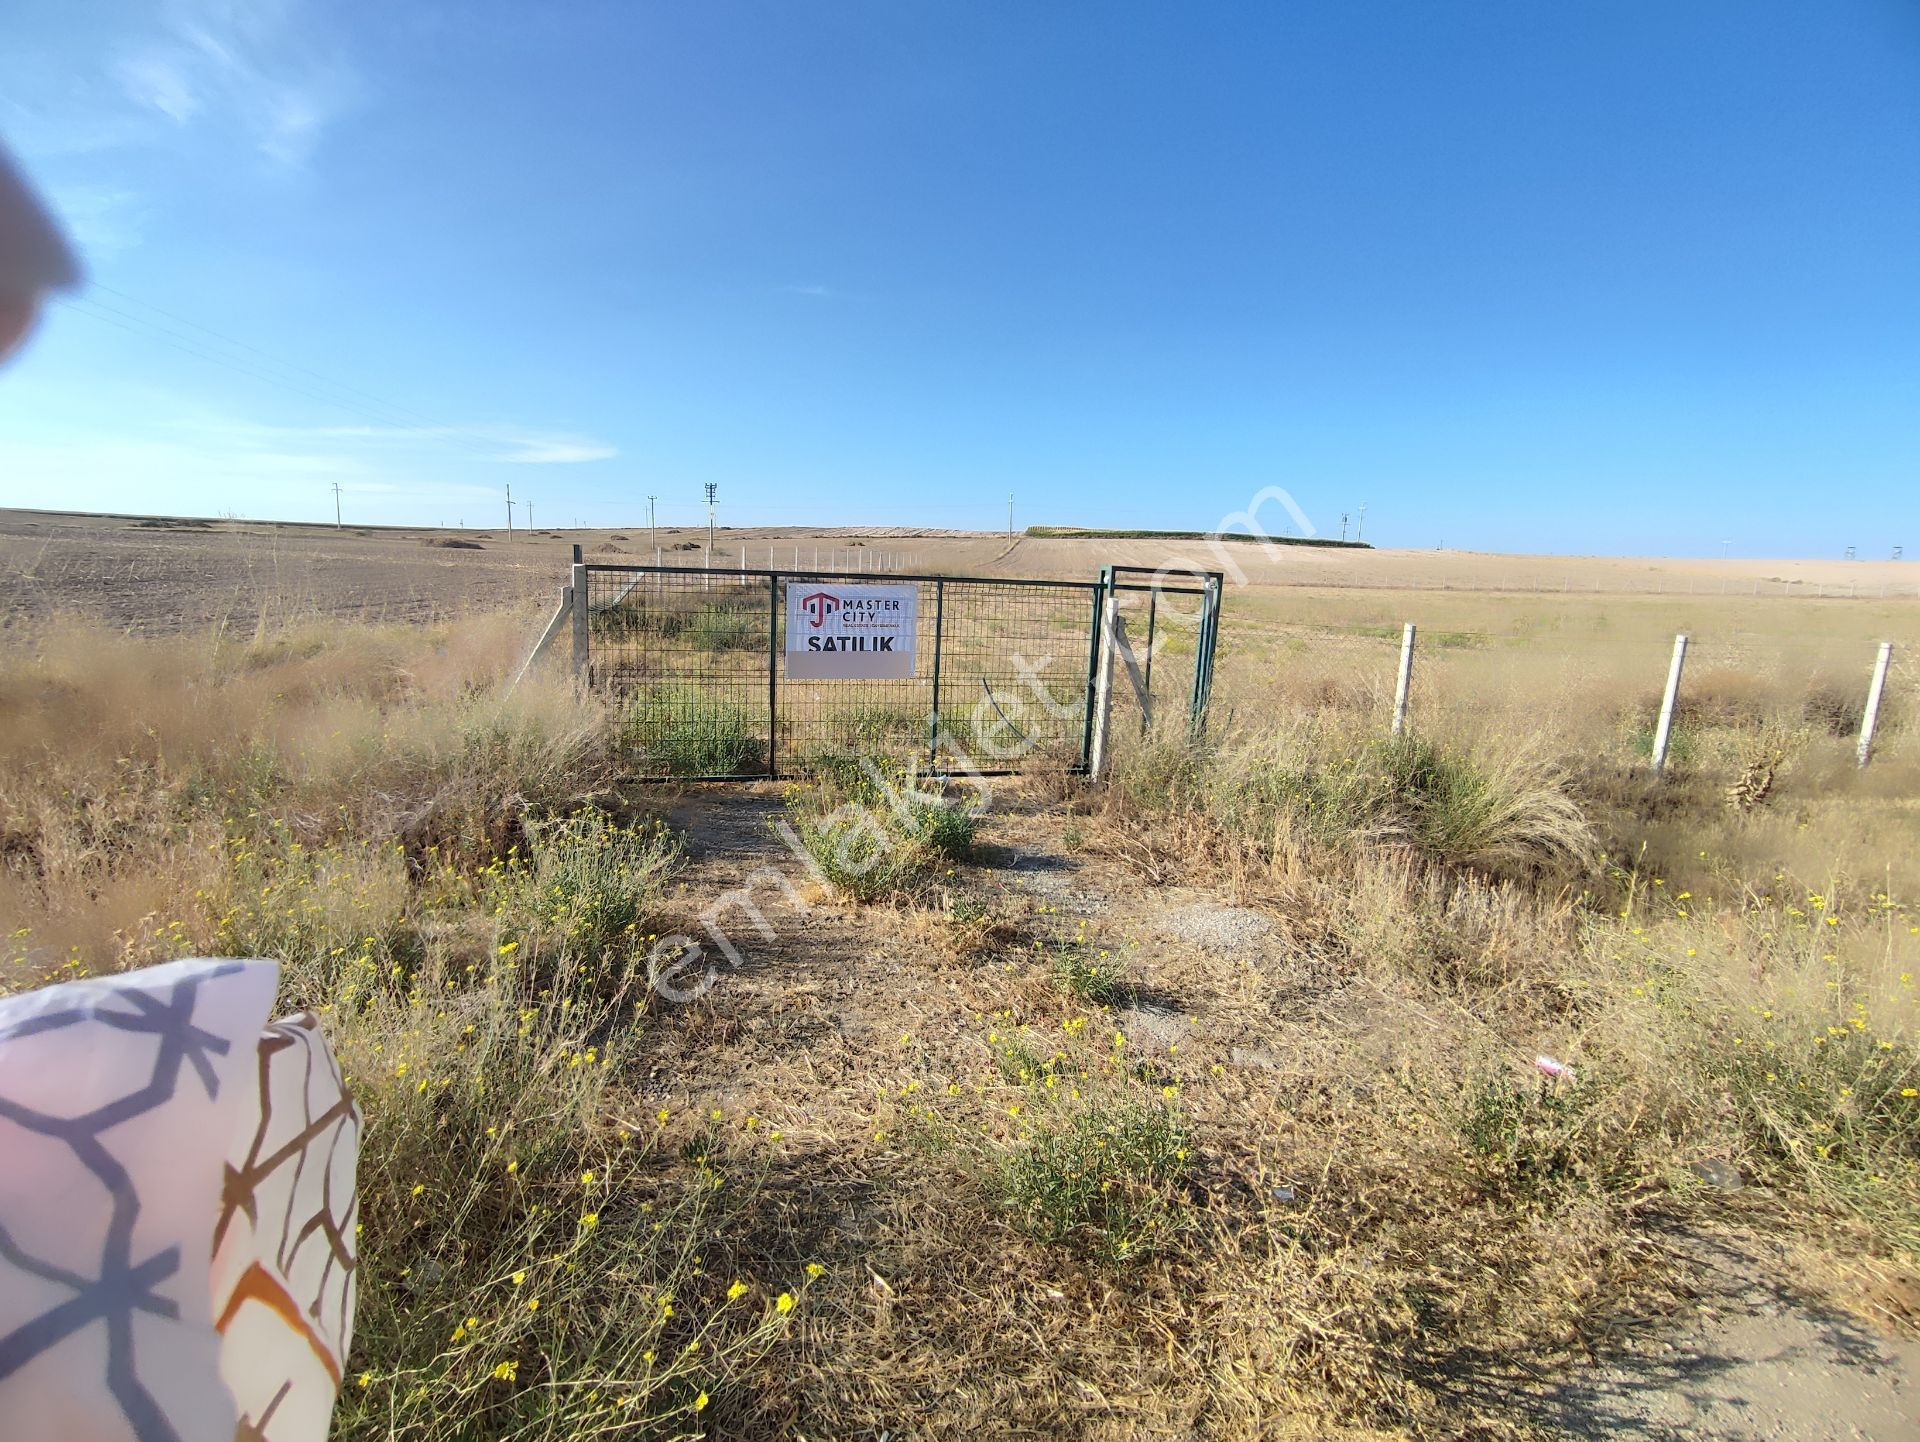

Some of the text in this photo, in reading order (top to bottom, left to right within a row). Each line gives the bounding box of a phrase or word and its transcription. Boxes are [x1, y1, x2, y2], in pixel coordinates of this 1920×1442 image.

[843, 600, 900, 610] MASTER
[842, 612, 876, 622] CITY
[808, 636, 895, 651] SATILIK
